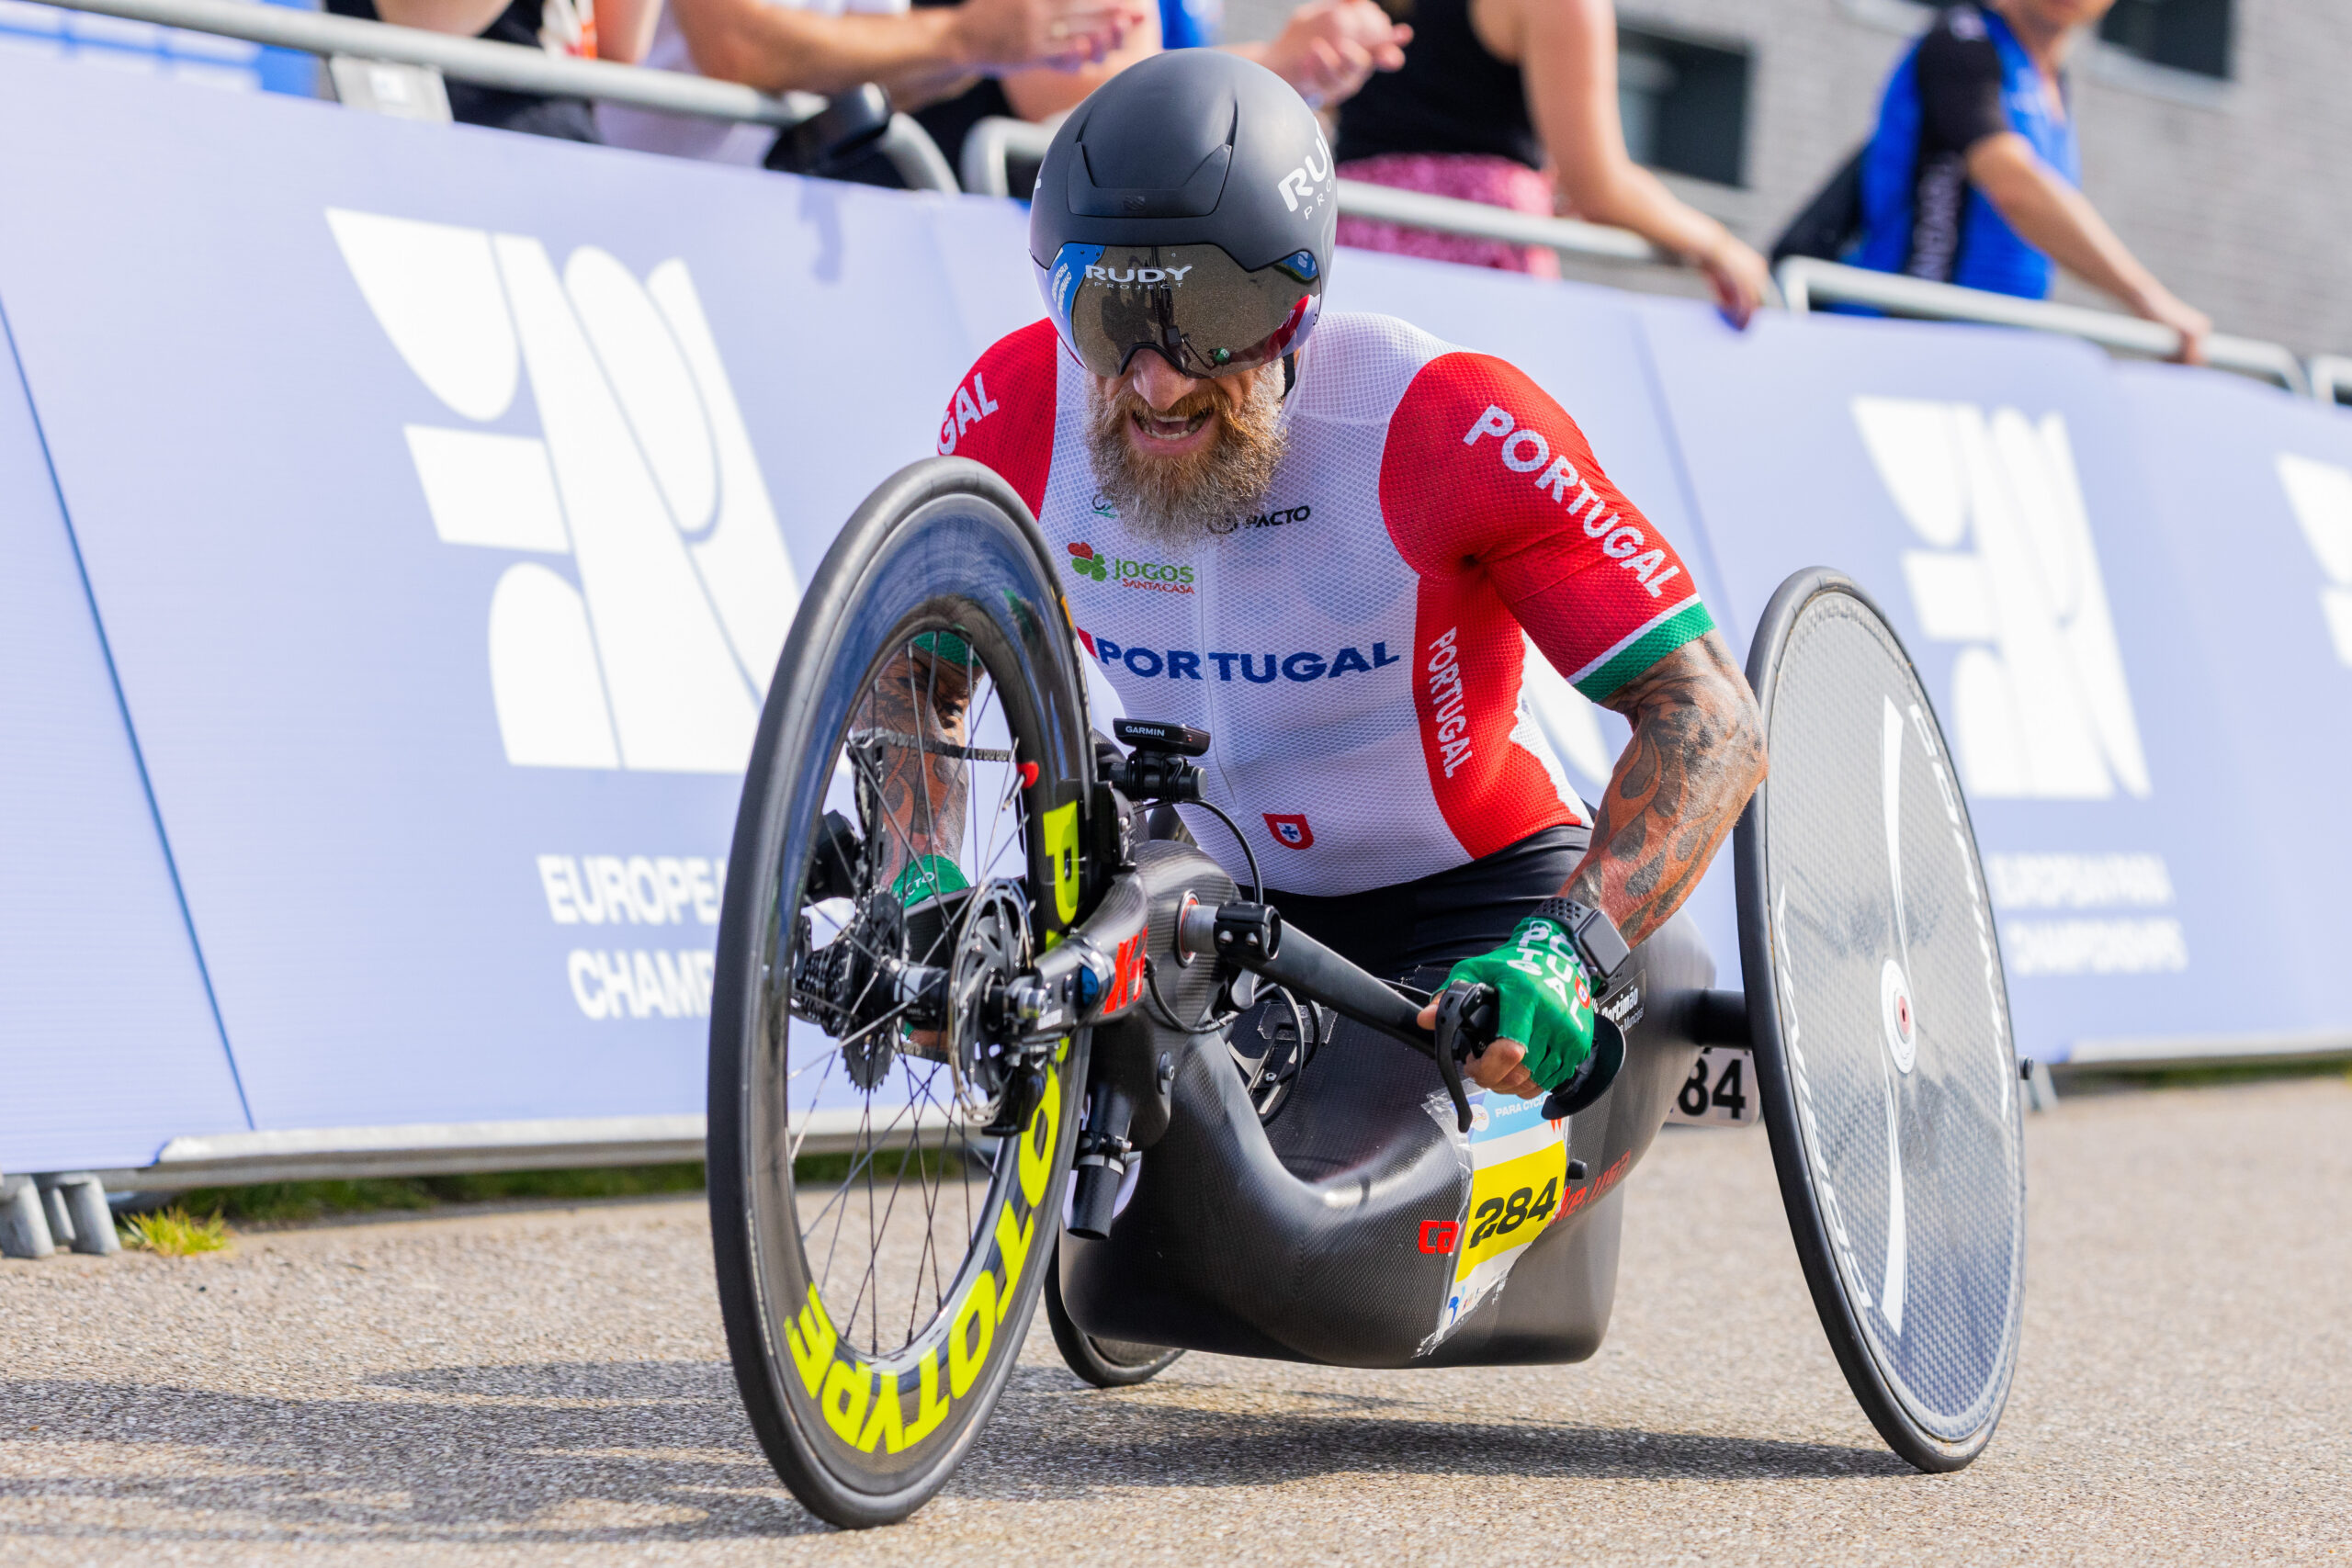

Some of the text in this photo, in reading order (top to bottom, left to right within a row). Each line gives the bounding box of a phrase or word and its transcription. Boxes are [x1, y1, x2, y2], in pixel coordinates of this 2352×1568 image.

[1278, 121, 1329, 212] RU
[1085, 265, 1193, 283] RUDY
[1094, 282, 1183, 290] PROJECT
[1463, 404, 1680, 598] PORTUGAL
[1113, 558, 1194, 583] JOGOS
[1095, 637, 1400, 683] PORTUGAL
[1125, 726, 1165, 737] GARMIN
[1428, 626, 1473, 779] PORTUGAL
[537, 854, 727, 926] EUROPE
[1494, 1103, 1522, 1118] PARA
[1671, 1057, 1747, 1120] 84
[784, 800, 1080, 1455] POTOTYPE
[1469, 1177, 1557, 1249] 284
